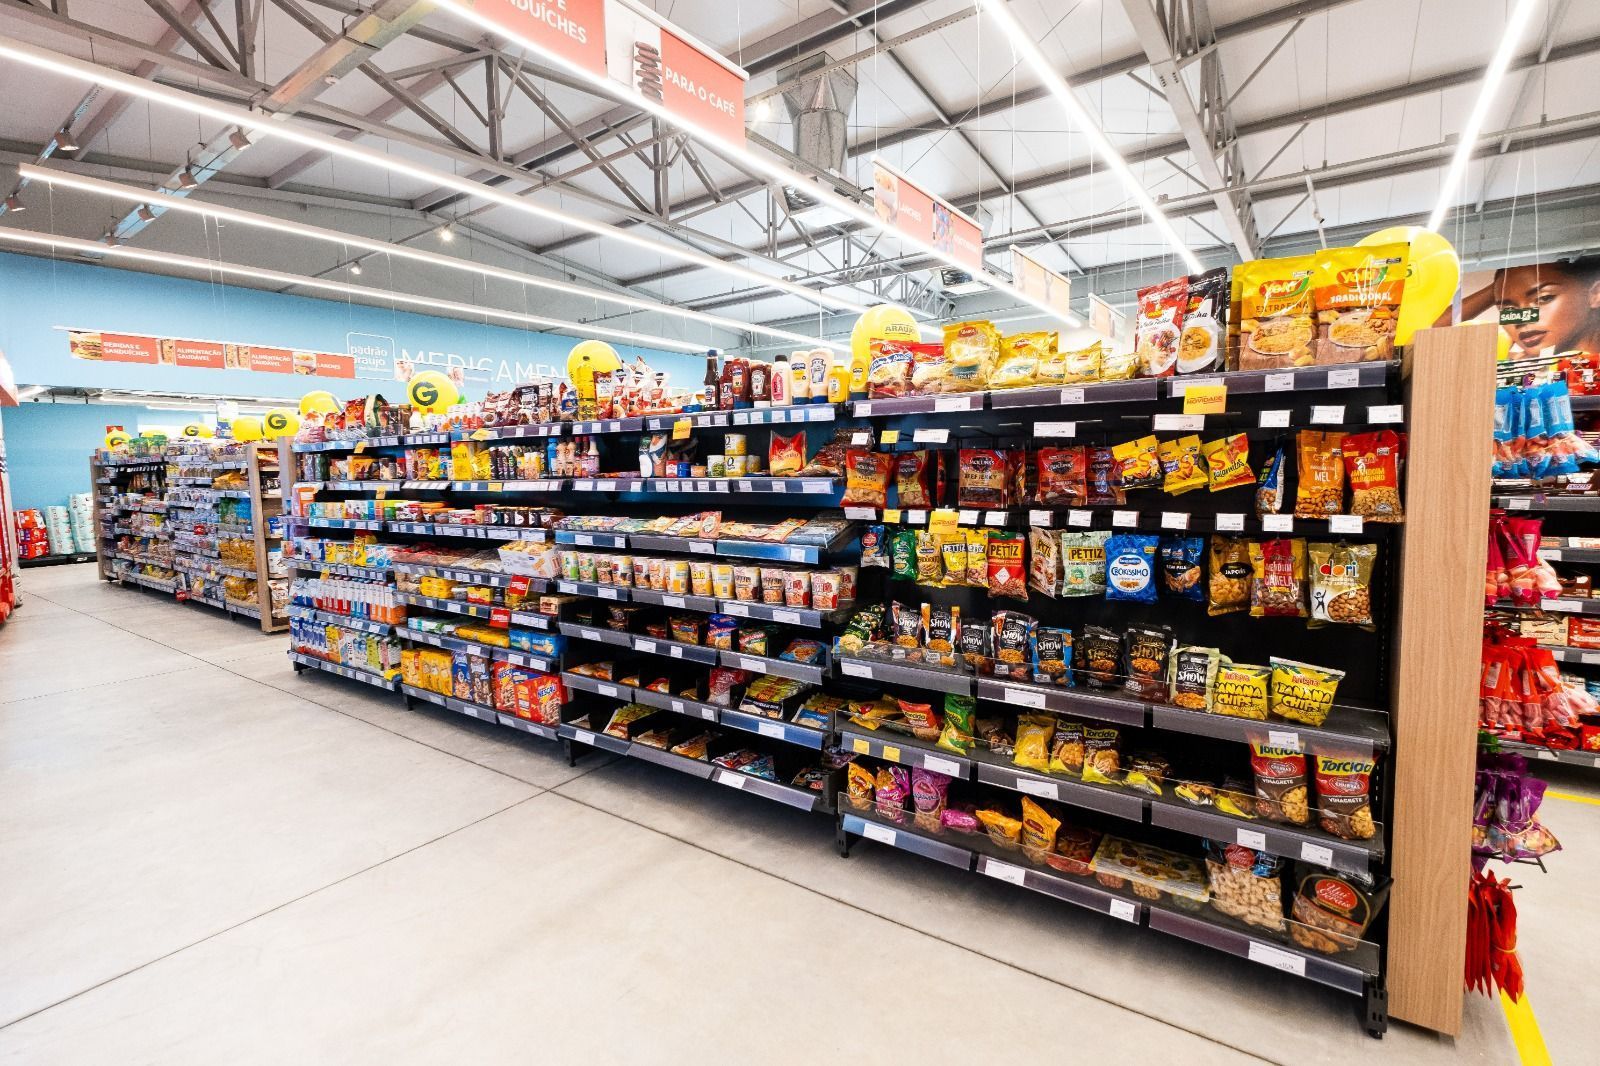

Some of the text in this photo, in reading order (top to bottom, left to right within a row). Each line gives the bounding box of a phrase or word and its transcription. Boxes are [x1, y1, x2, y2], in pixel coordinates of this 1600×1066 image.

[665, 66, 736, 118] PARA O CAFÉ
[1331, 292, 1392, 304] TRADICIONAL
[1256, 301, 1309, 314] EXTRAFINA
[1501, 312, 1521, 321] SAÍDA
[104, 341, 135, 350] BEBIDAS
[351, 343, 387, 357] padrão
[104, 347, 150, 357] SANDUÍCHES
[177, 347, 222, 357] ALIMENTAÇÃO
[177, 353, 211, 362] SAUDÁVEL
[251, 353, 291, 362] ALIMENTAÇÃO
[252, 359, 281, 367] SAUDÁVEL
[317, 362, 341, 370] LANCHES
[412, 382, 438, 406] G
[268, 413, 288, 430] G
[185, 425, 199, 437] G
[1314, 471, 1330, 482] MEL
[990, 545, 1019, 557] PETTIZ
[1071, 549, 1103, 559] PETTIZ
[1319, 559, 1358, 577] dori
[899, 617, 917, 628] SHOW
[930, 618, 951, 629] SHOW
[962, 635, 983, 646] SHOW
[1002, 630, 1024, 643] SHOW
[1038, 641, 1062, 651] SHOW
[1130, 644, 1165, 661] SHOW
[1178, 670, 1205, 684] SHOW
[1278, 682, 1332, 704] BANANA
[1216, 693, 1252, 708] CHIPS
[1281, 695, 1322, 712] CHIPS
[1086, 729, 1116, 738] Torcida
